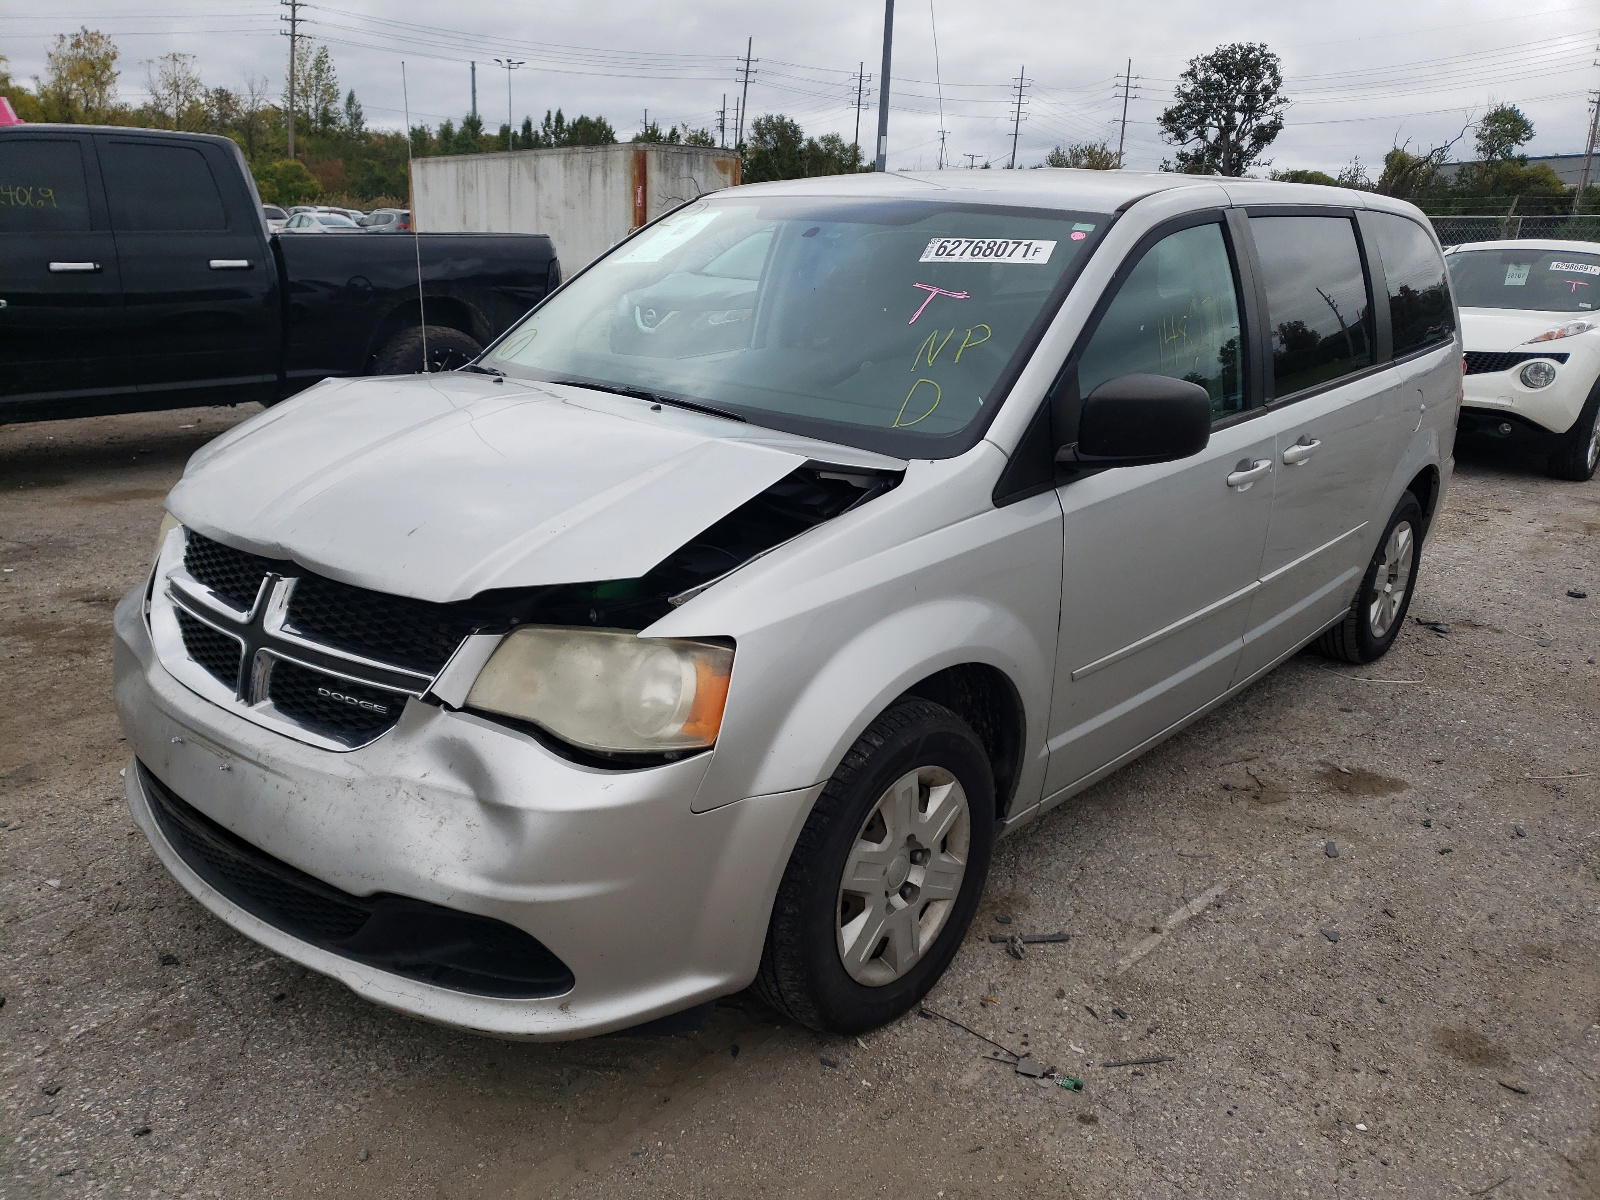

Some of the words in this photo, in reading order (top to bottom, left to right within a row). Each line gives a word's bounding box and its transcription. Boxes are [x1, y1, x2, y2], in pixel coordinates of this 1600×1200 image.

[908, 282, 971, 325] T
[892, 378, 941, 428] D
[318, 687, 388, 714] DODGE
